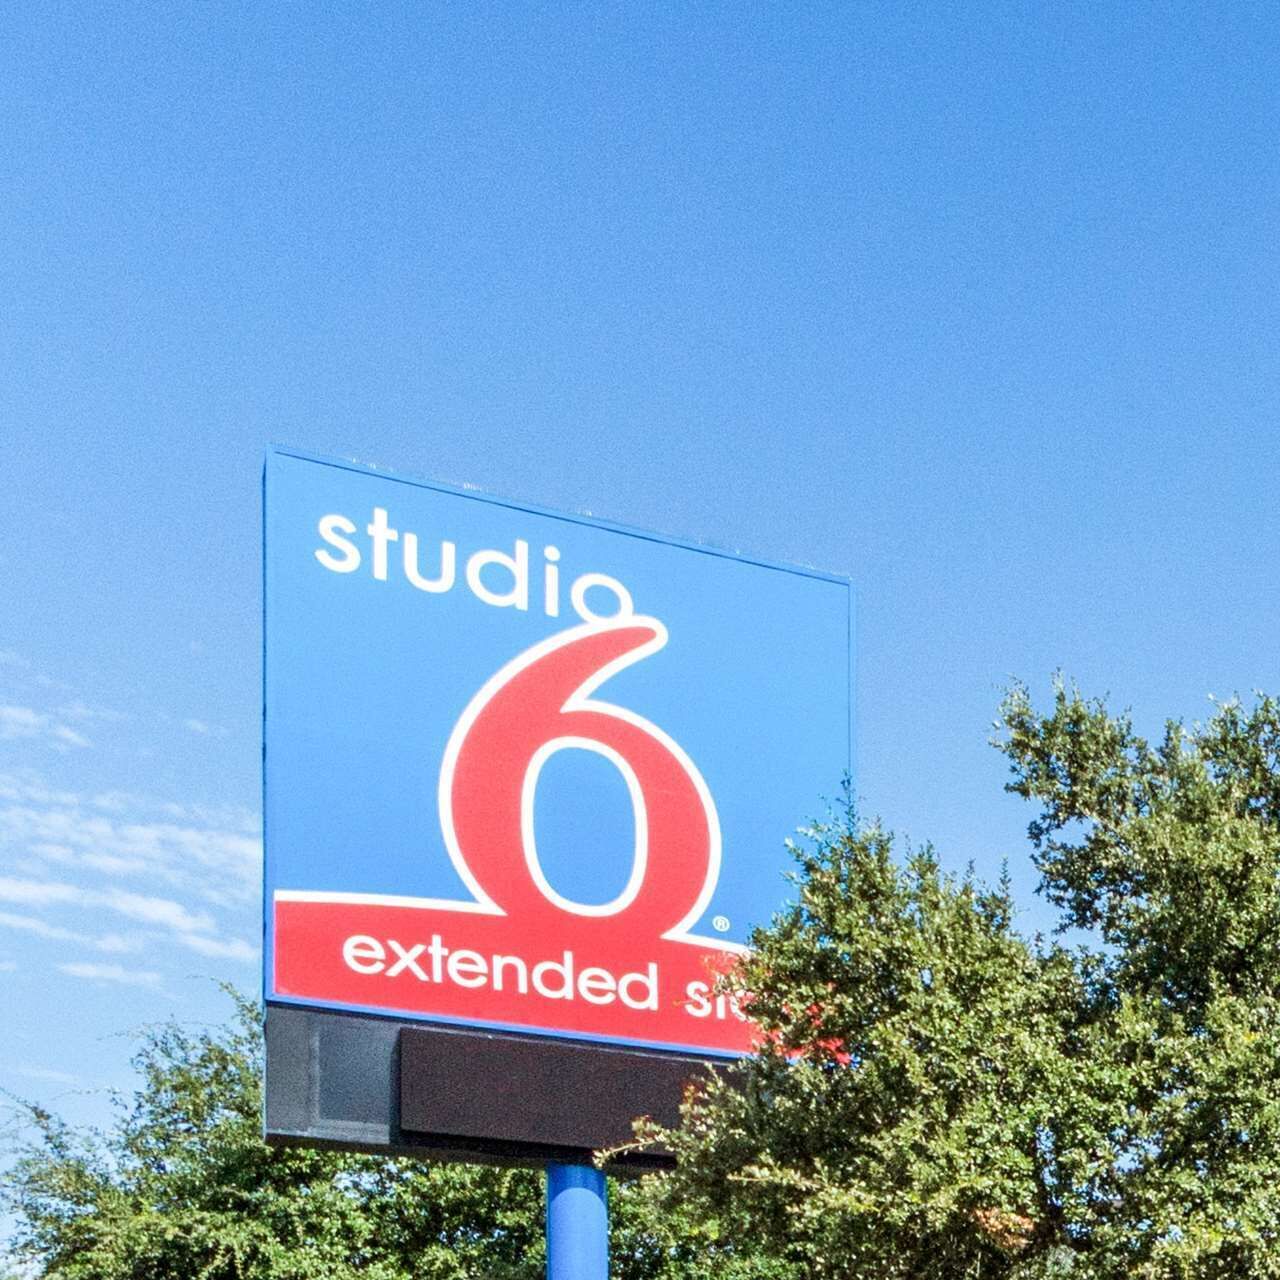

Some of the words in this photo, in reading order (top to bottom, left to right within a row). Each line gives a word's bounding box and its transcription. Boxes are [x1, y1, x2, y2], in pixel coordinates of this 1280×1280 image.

[314, 507, 634, 624] studio
[437, 615, 722, 940] 6
[342, 934, 659, 1012] extended
